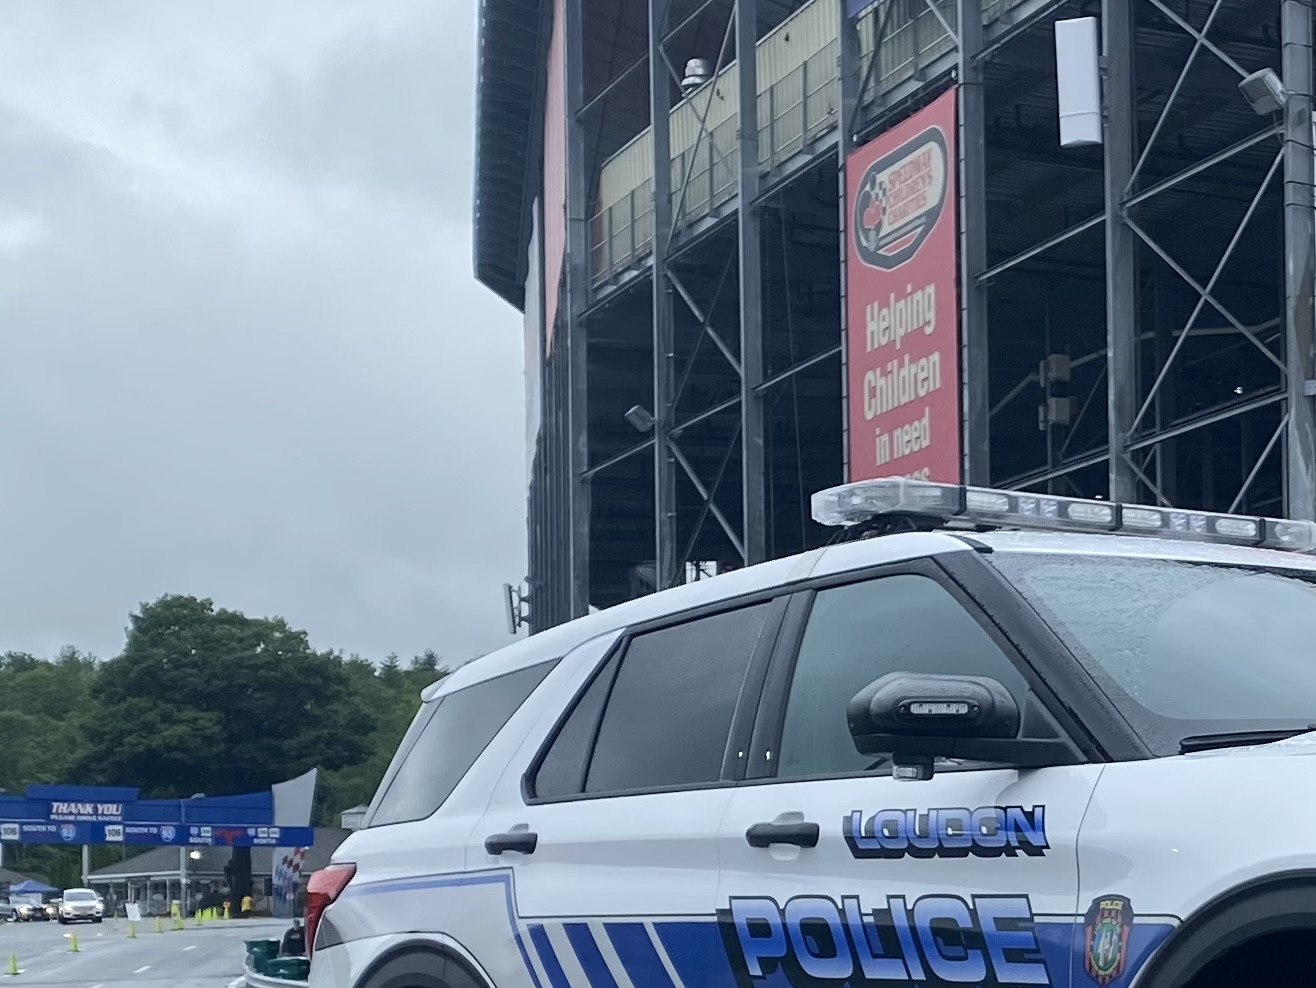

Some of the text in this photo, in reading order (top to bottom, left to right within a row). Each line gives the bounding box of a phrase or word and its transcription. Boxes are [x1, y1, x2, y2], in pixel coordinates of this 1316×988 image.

[866, 282, 936, 353] Helping
[864, 351, 941, 421] Children
[875, 406, 930, 466] in need
[2, 827, 17, 836] 106
[51, 802, 122, 815] THANK YOU
[107, 828, 121, 837] 106
[844, 805, 1050, 858] LOUDON
